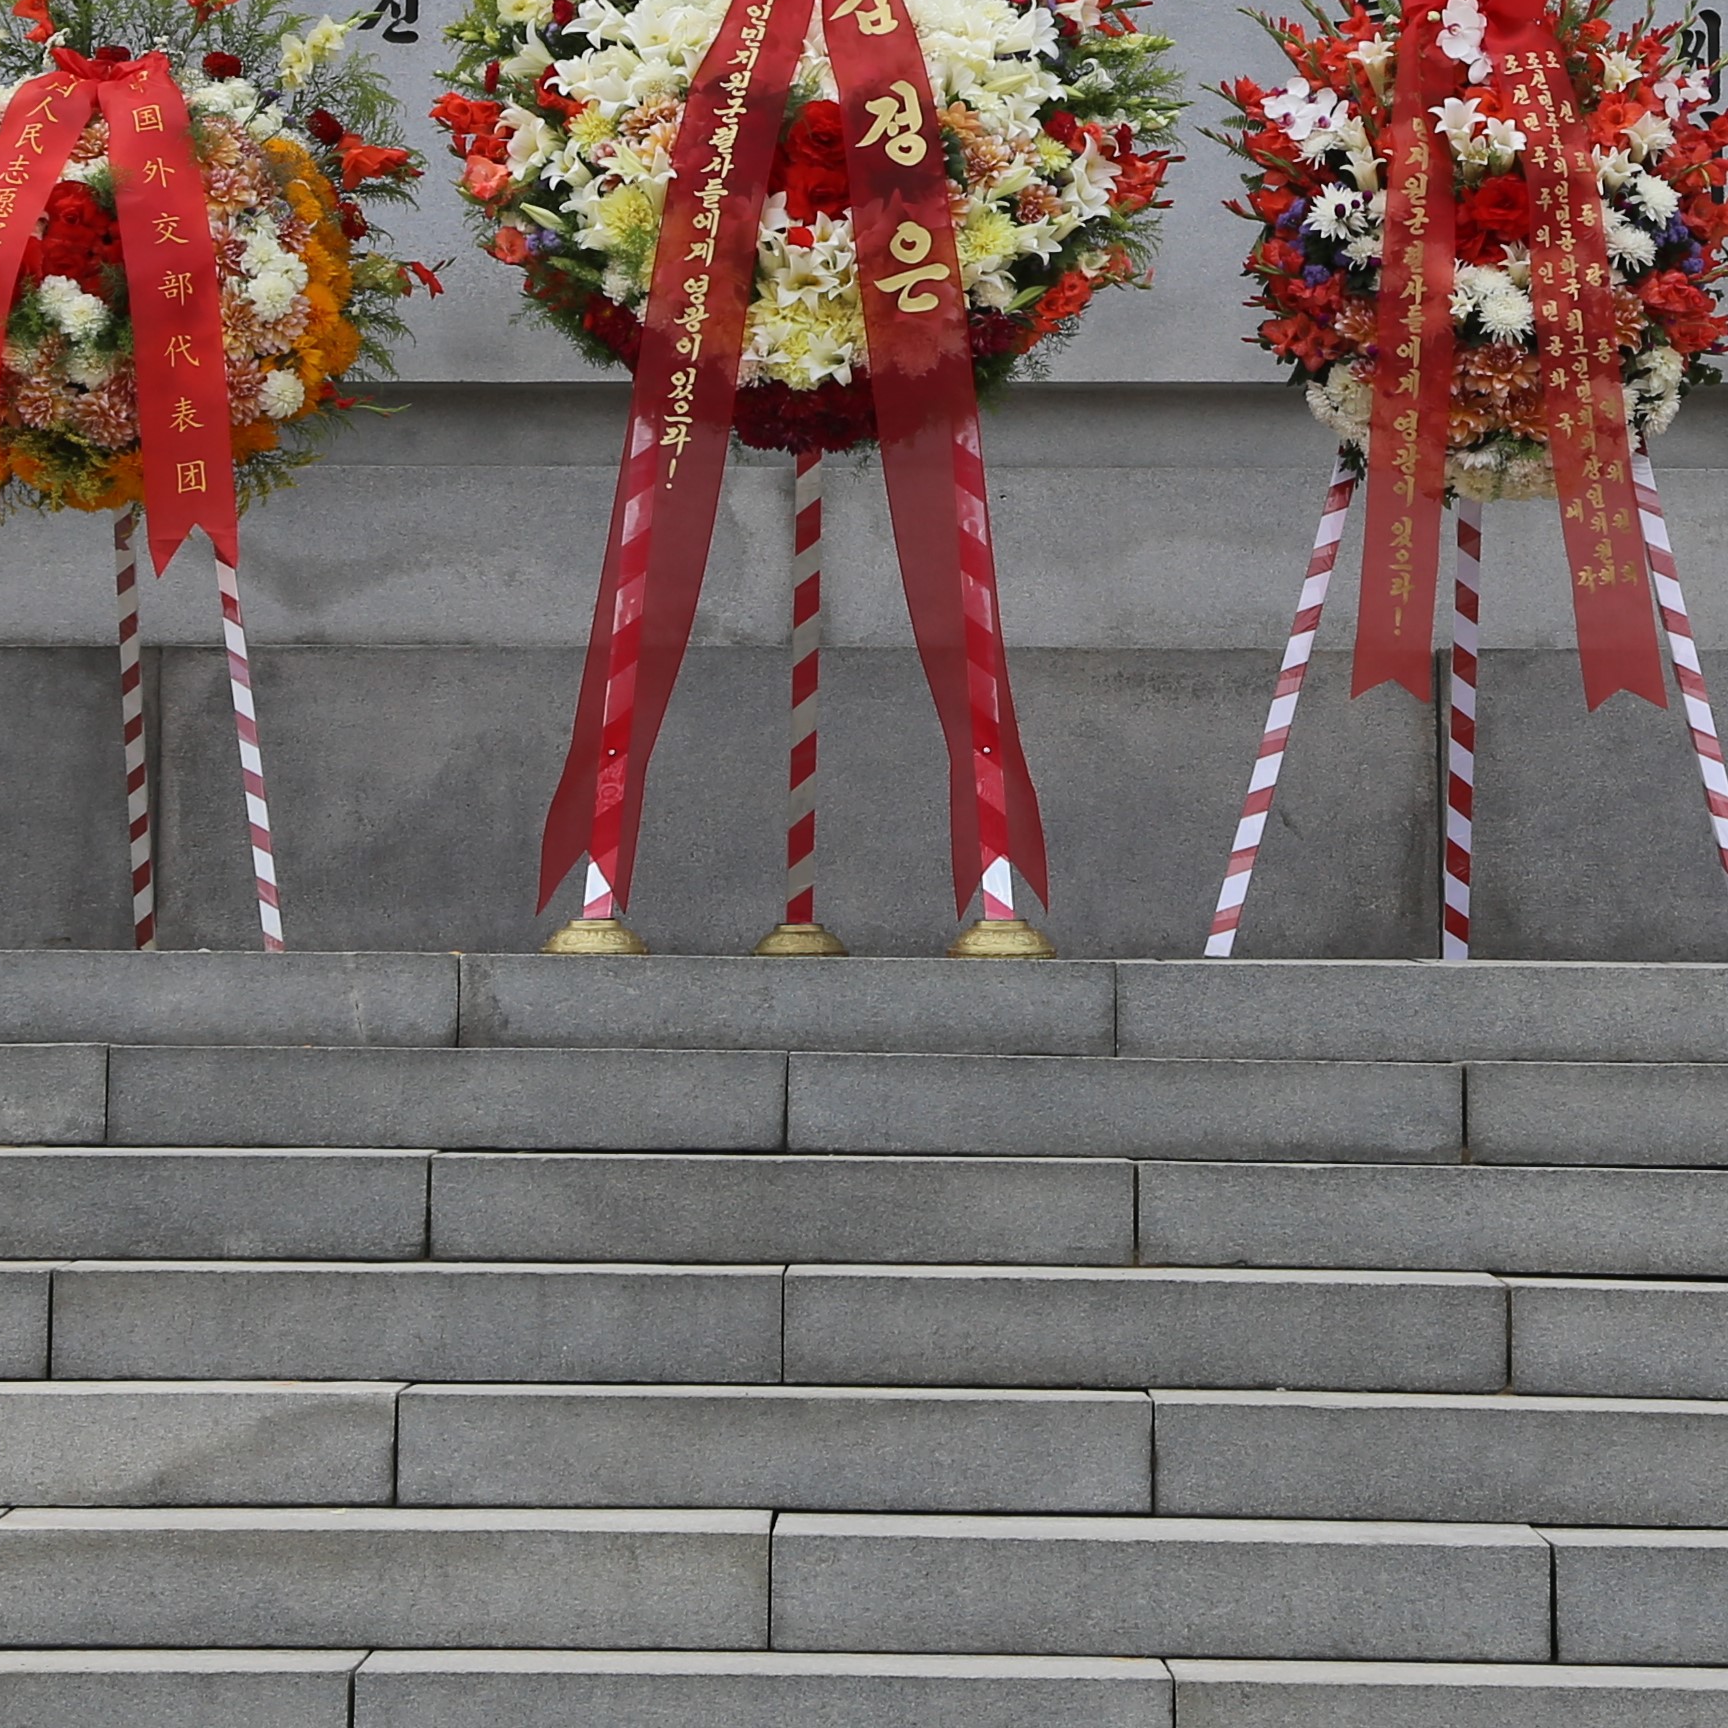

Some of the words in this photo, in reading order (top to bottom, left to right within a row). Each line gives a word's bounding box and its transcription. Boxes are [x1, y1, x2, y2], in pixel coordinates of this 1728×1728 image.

[128, 70, 209, 494] 中国外交部代表团
[672, 274, 710, 362] 영광이
[659, 366, 698, 490] 있으라!
[1390, 412, 1423, 509] 영광이
[1386, 518, 1416, 637] 있으라!
